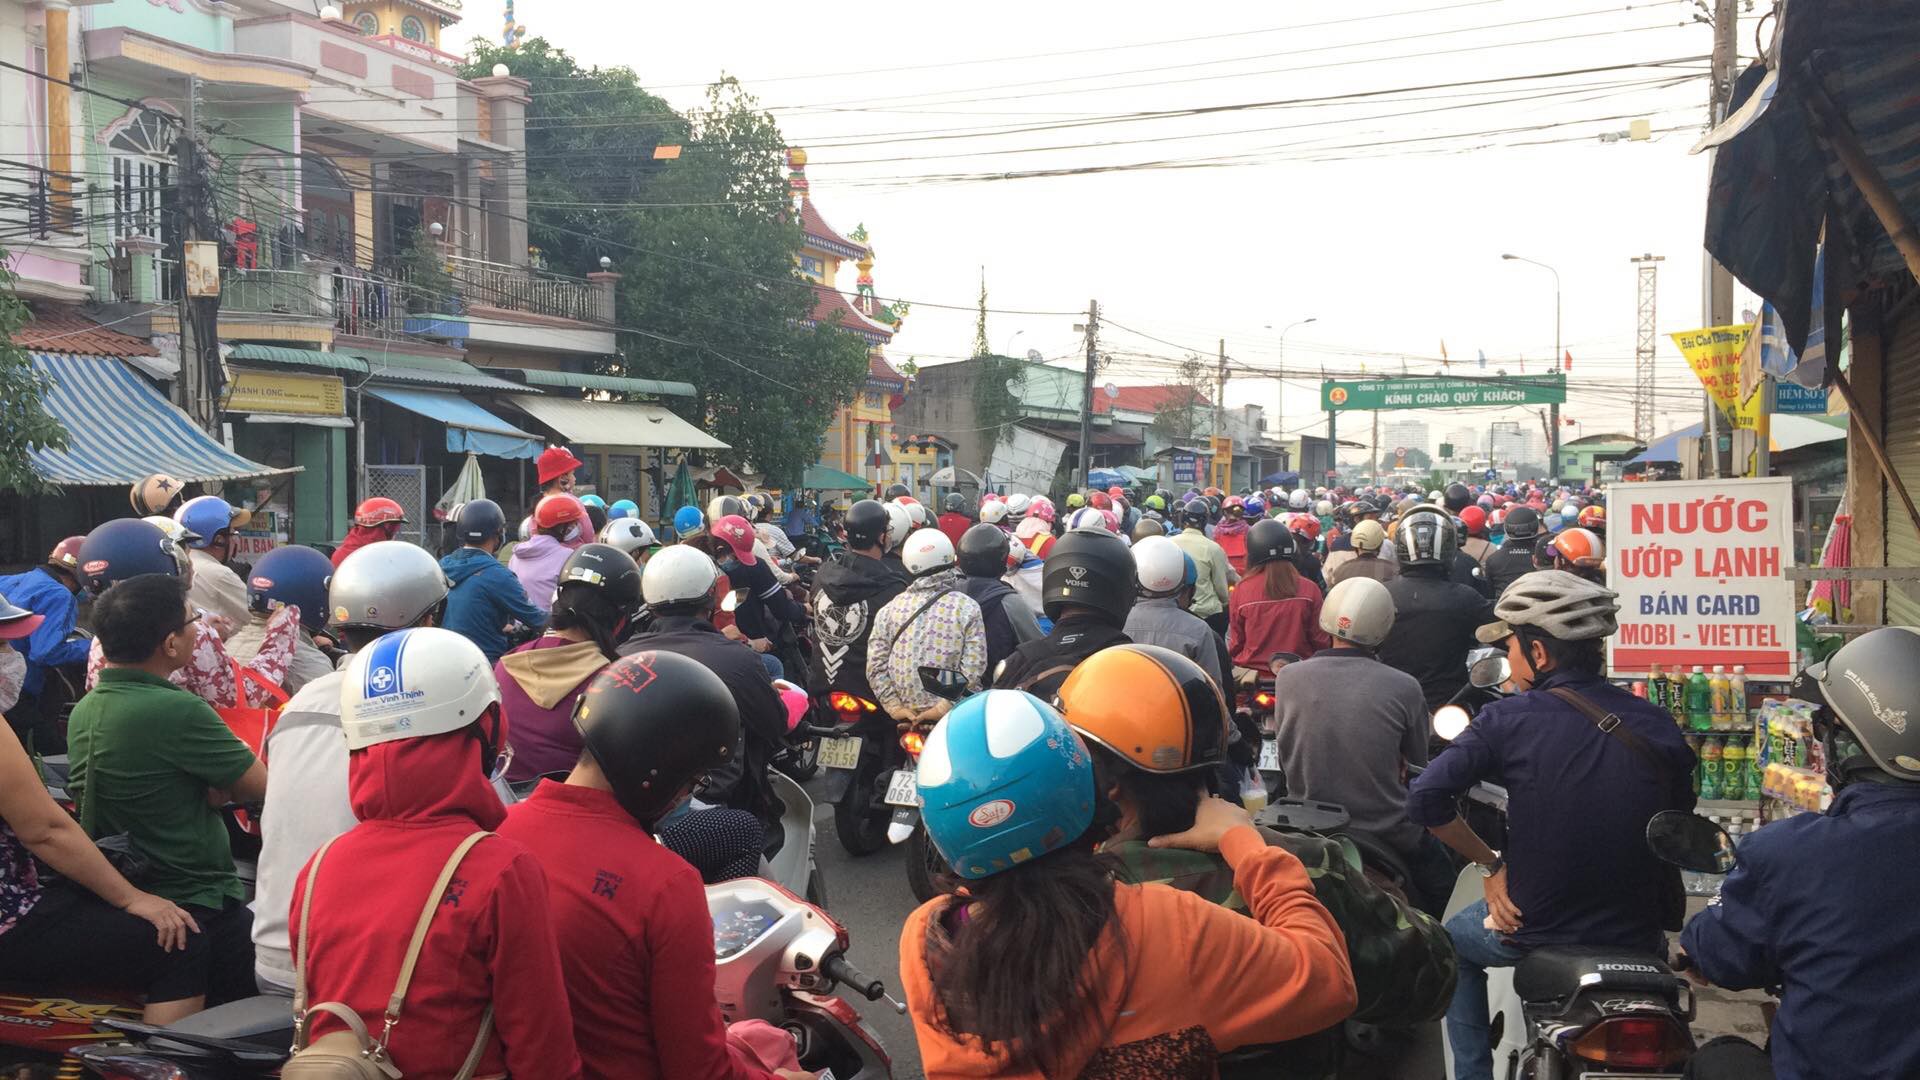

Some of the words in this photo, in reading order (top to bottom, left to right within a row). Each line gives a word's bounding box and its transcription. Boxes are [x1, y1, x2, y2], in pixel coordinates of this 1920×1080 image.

[1742, 330, 1750, 341] M
[1385, 391, 1412, 405] KÍNH
[1416, 390, 1449, 404] CHÀO
[1453, 389, 1478, 404] QUÝ
[1483, 389, 1525, 401] KHÁCH
[1631, 495, 1768, 534] NƯỚC
[1620, 543, 1683, 578] ƯỚP
[1695, 547, 1779, 584] LẠNH
[1065, 579, 1089, 588] YOHE
[1640, 591, 1688, 615] BÁN
[1696, 595, 1760, 615] CARD
[1620, 624, 1675, 645] MOBI
[1698, 624, 1781, 647] VIETTEL
[821, 752, 856, 765] 251.56
[1597, 963, 1659, 973] HONDA
